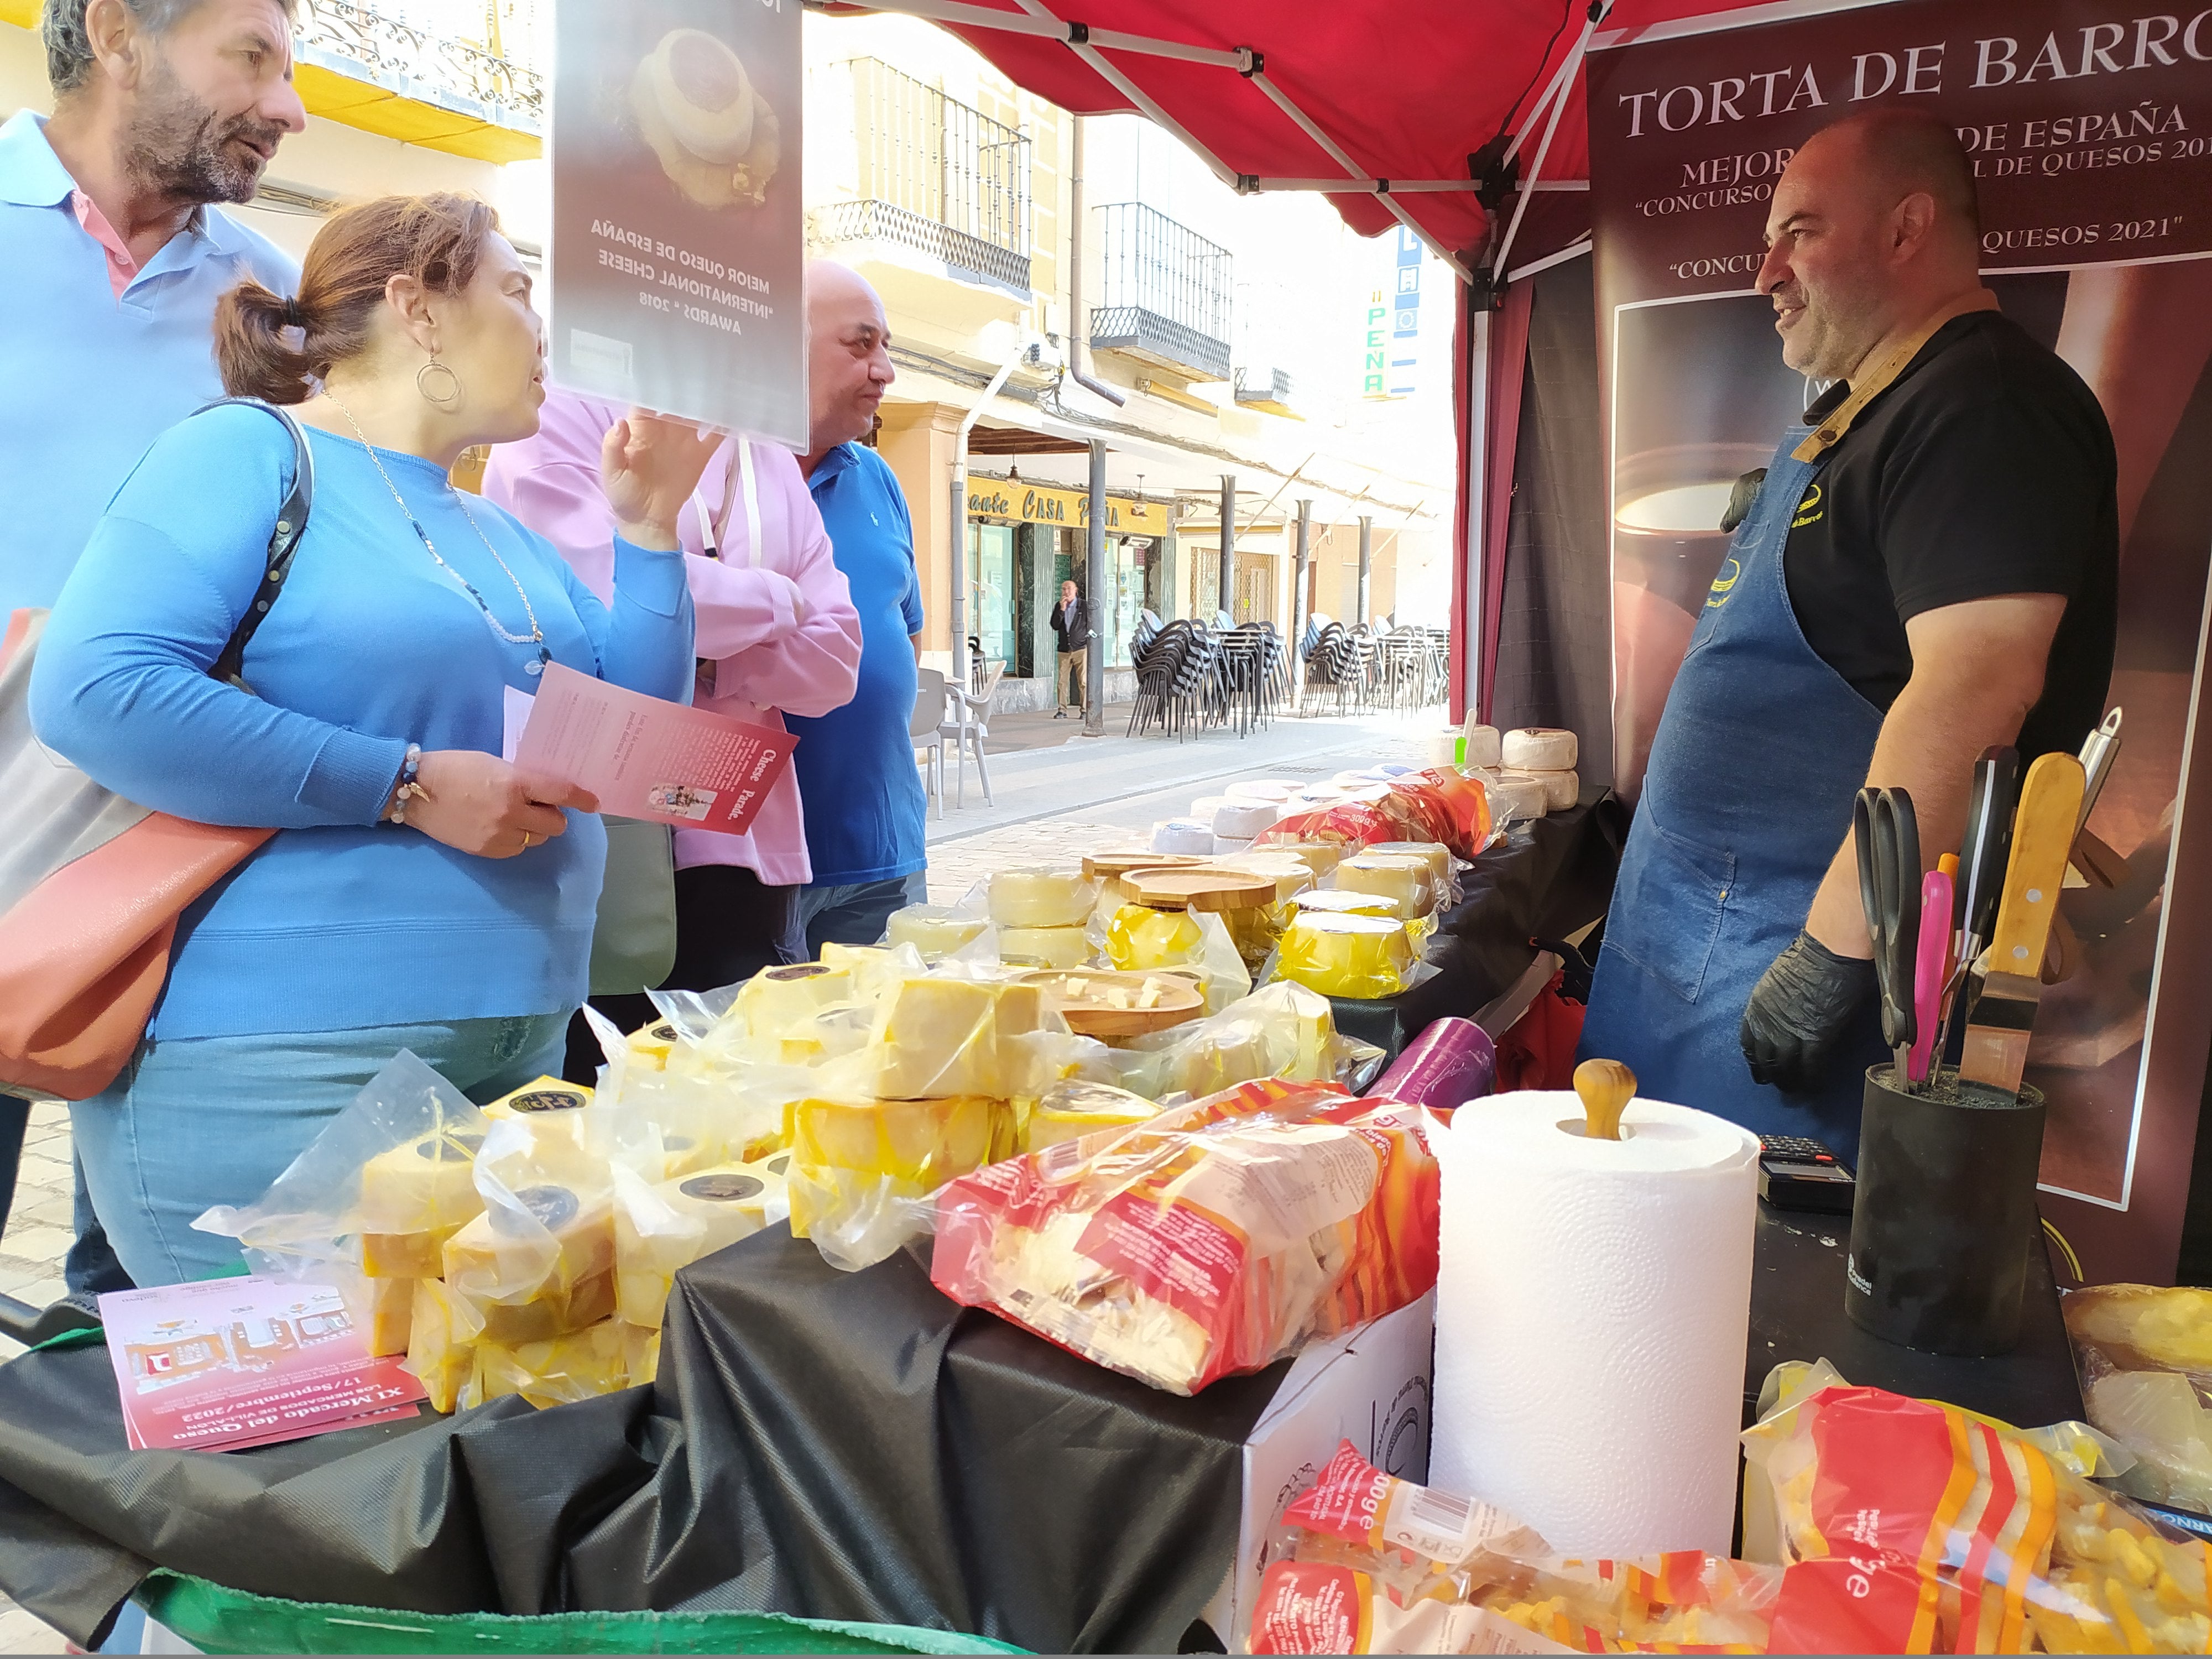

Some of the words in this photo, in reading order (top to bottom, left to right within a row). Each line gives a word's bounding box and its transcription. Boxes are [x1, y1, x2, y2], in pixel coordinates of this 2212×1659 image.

[1619, 62, 1829, 138] TORTA
[1848, 40, 1947, 103] DE
[1954, 123, 2008, 153] DE
[2020, 100, 2189, 149] ESPAÑA
[1995, 156, 2033, 177] DE
[2041, 142, 2163, 177] QUESOS
[1982, 223, 2100, 254] QUESOS
[1669, 252, 1769, 279] “CONCU
[1022, 489, 1065, 522] CASA
[749, 749, 777, 783] Cheese
[279, 1391, 354, 1411] MERCADOS
[356, 1384, 382, 1394] LOS
[377, 1387, 404, 1400] XI
[258, 1407, 278, 1415] DE
[284, 1395, 374, 1418] Mercado
[173, 1423, 242, 1440] Queso
[247, 1415, 278, 1428] del
[1361, 1472, 1390, 1514] 00g
